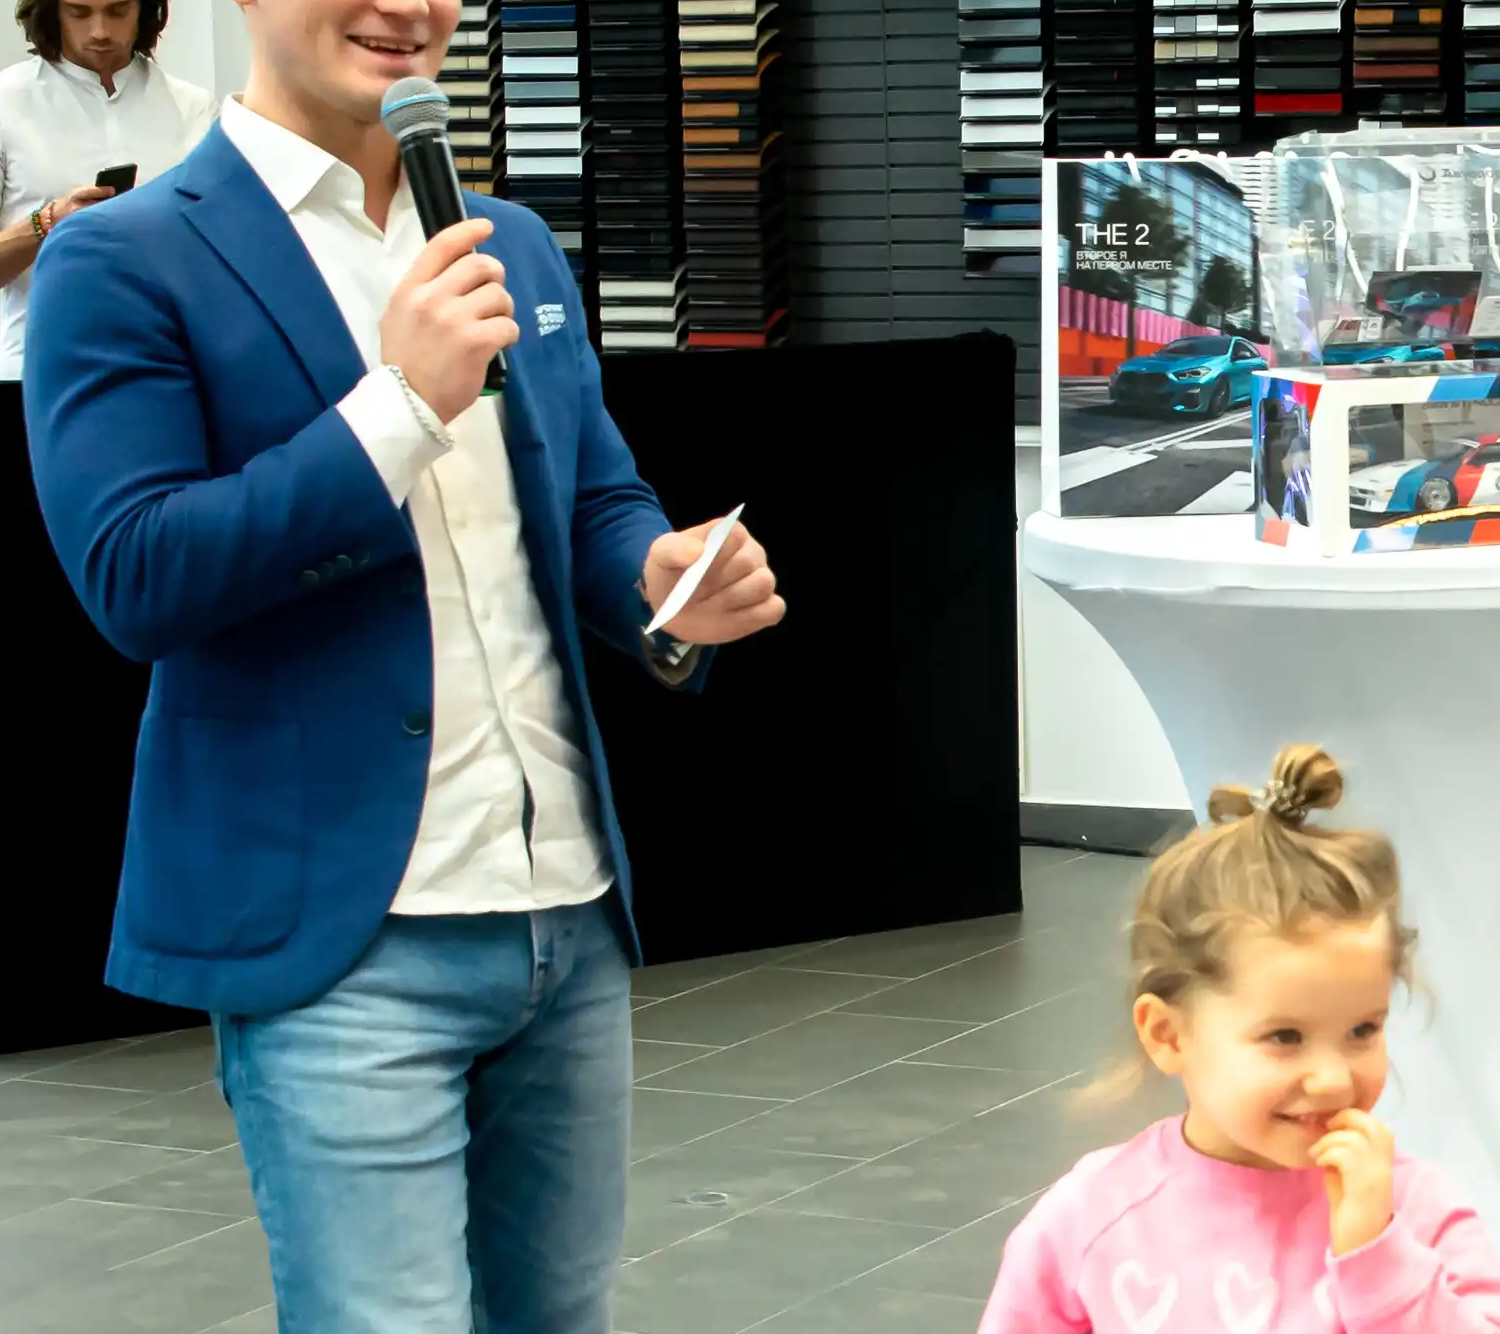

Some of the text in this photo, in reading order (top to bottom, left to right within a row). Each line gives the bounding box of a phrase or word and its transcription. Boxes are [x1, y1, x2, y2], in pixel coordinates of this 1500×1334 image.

[1075, 222, 1151, 246] THE 2
[1076, 250, 1119, 262] ВТОРОЕ
[1076, 260, 1091, 271] НА
[1137, 260, 1173, 271] МЕСТЕ
